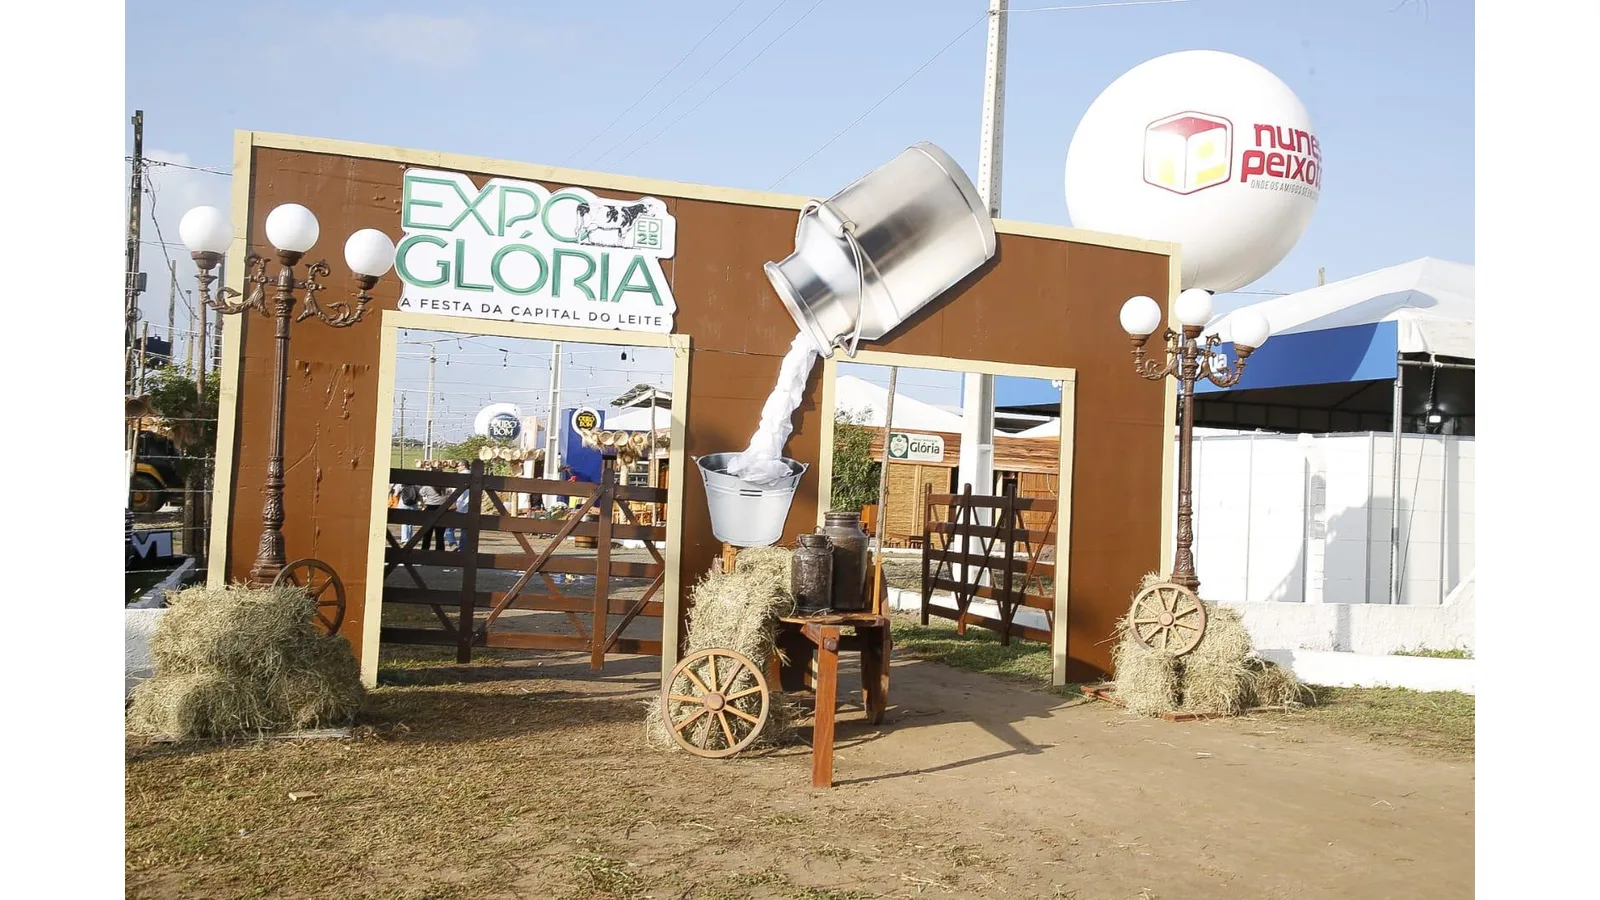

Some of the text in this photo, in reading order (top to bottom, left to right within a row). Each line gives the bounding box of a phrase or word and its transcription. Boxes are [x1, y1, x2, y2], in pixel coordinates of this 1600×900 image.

[1253, 123, 1322, 160] nune
[1250, 179, 1270, 191] ONDE
[403, 174, 589, 244] EXPO
[637, 220, 660, 232] ED
[637, 232, 658, 246] 25
[395, 229, 664, 307] GLÓRIA
[400, 297, 662, 327] A FESTA DA CAPITAL DO LEITE
[493, 427, 514, 437] BOM
[909, 441, 940, 454] Glória
